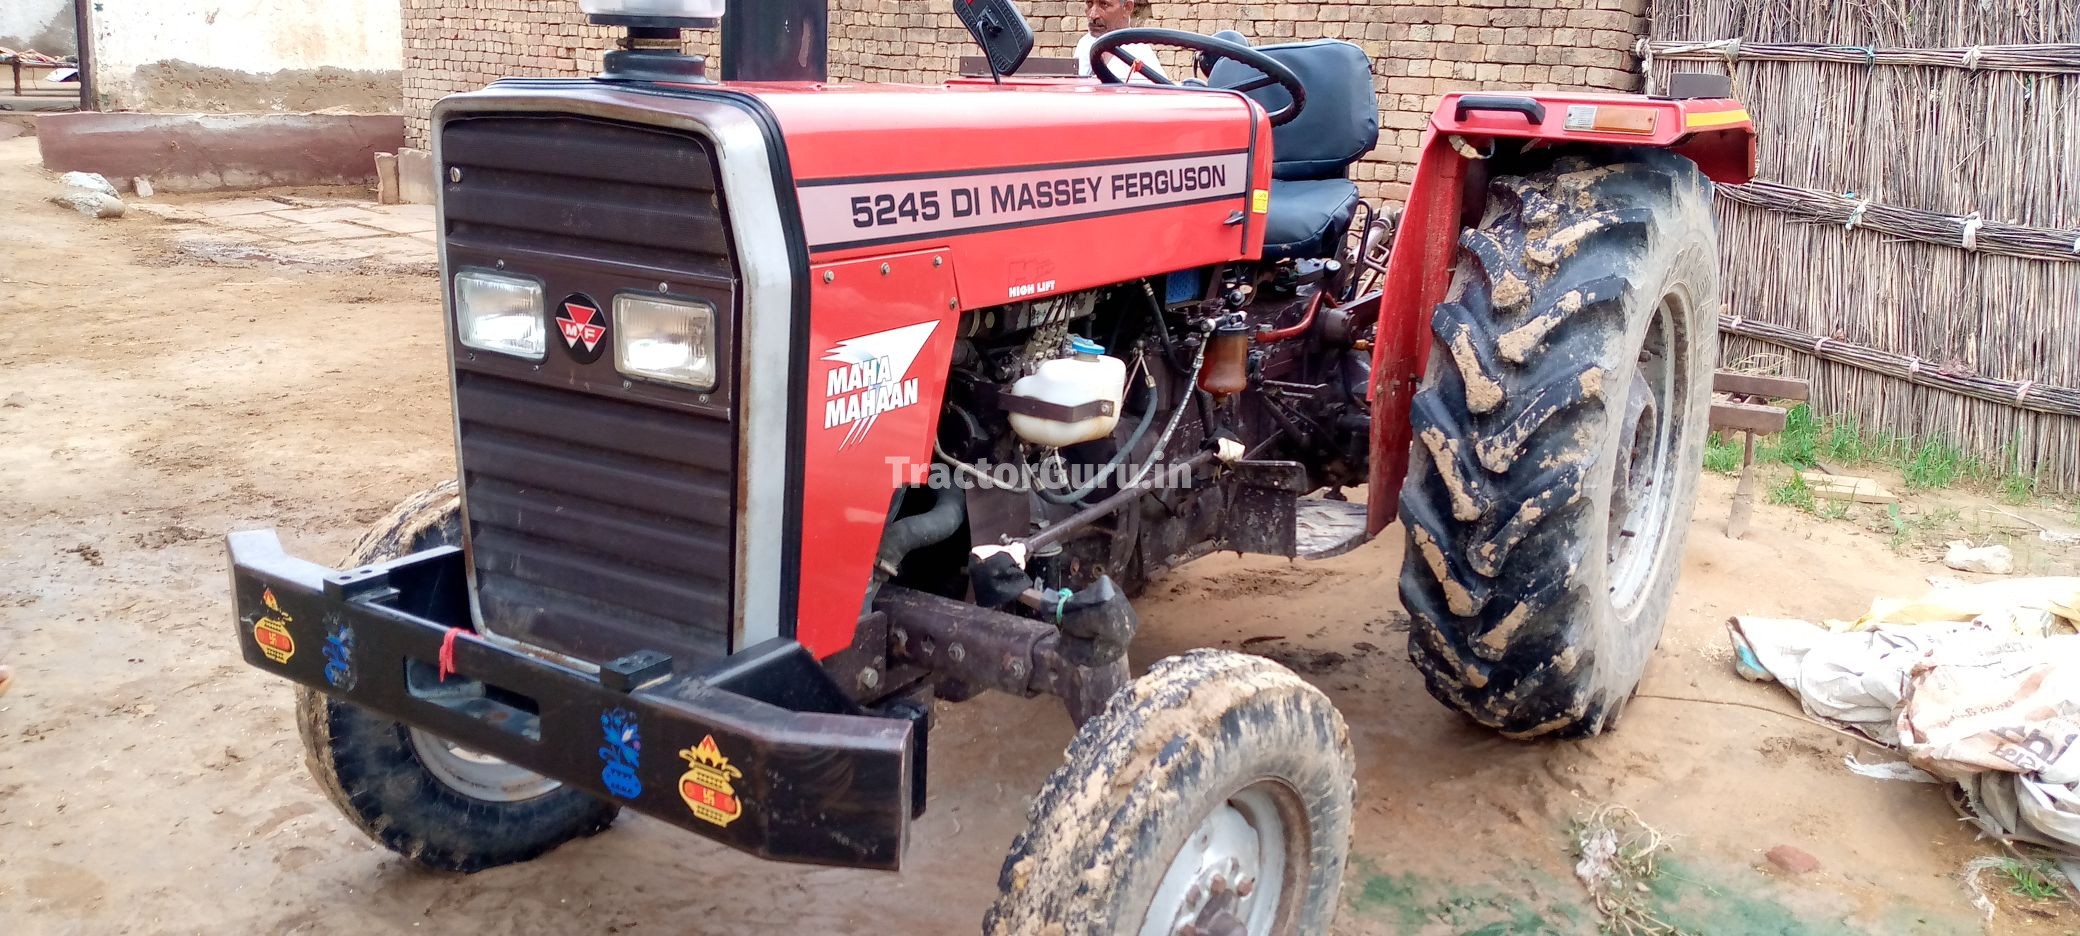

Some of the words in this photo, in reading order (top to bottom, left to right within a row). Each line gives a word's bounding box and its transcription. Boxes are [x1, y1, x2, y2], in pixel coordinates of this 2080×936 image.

[851, 190, 941, 228] 5245
[952, 188, 981, 217] DI
[991, 176, 1103, 213] MASSEY
[1111, 164, 1226, 200] FERGUSON
[1008, 283, 1035, 298] HIGH
[1036, 280, 1056, 293] LIFT
[826, 355, 893, 398] MAHA
[824, 377, 919, 430] MAHAAN
